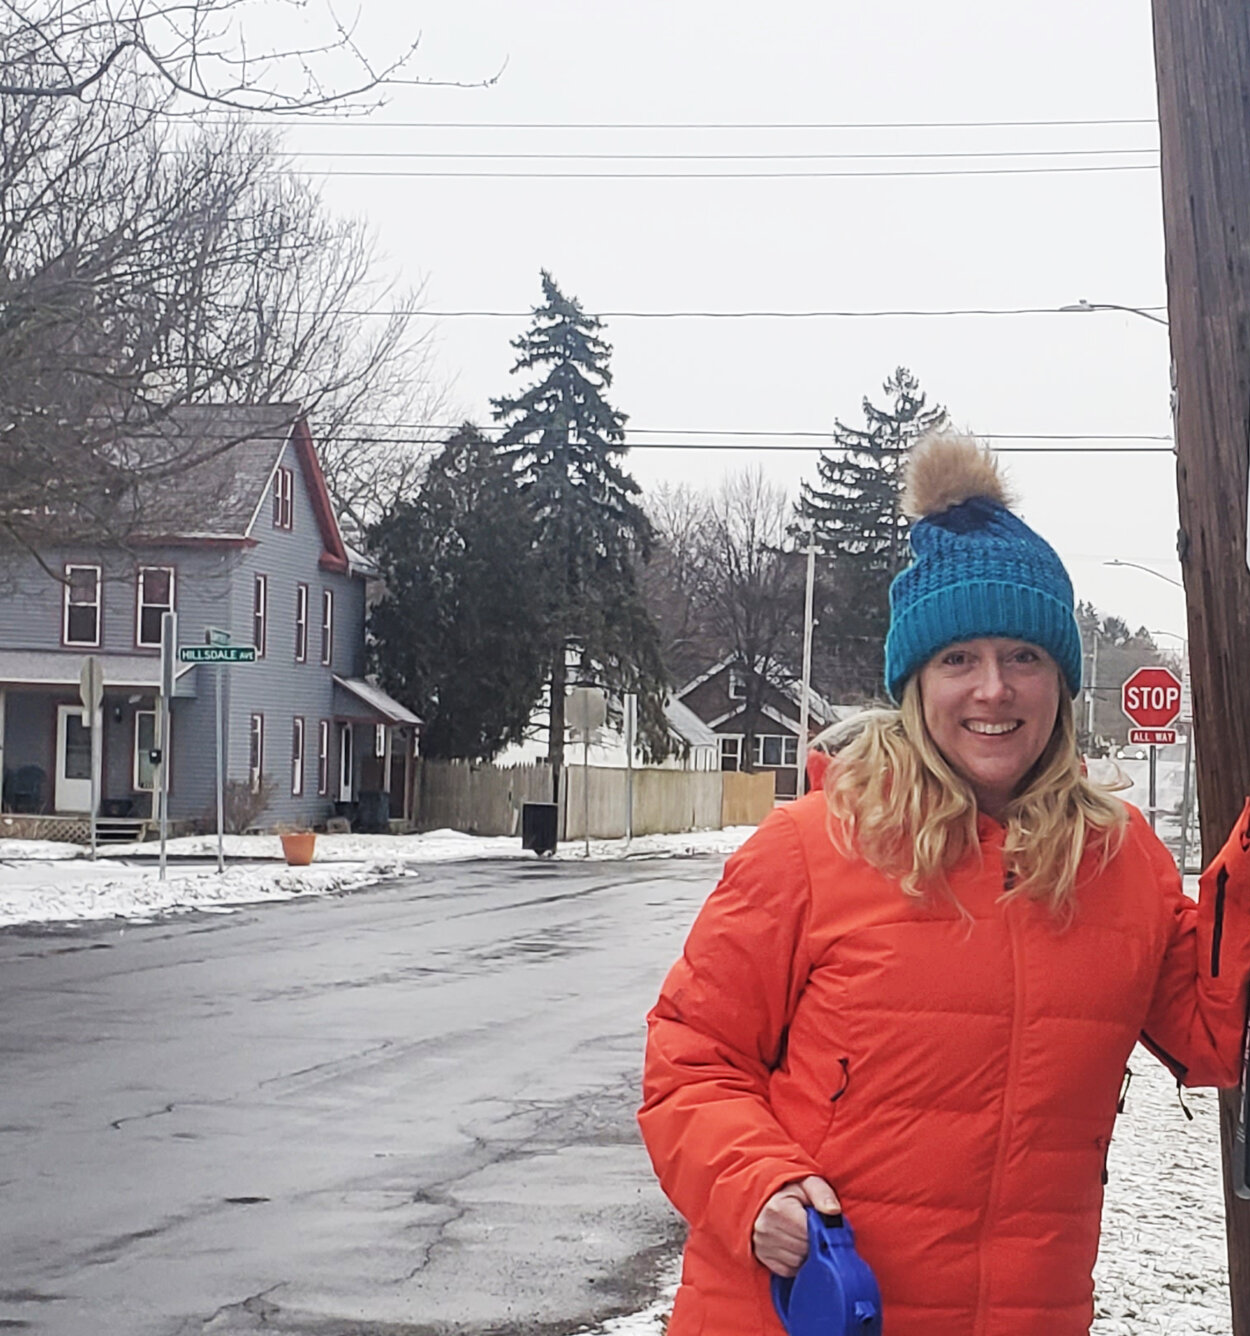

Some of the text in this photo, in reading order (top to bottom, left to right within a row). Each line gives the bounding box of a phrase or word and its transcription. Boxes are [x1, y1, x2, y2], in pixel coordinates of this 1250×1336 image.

[182, 650, 254, 660] HILLSDALE AVE
[1127, 686, 1179, 710] STOP
[1133, 732, 1174, 742] ALL WAY
